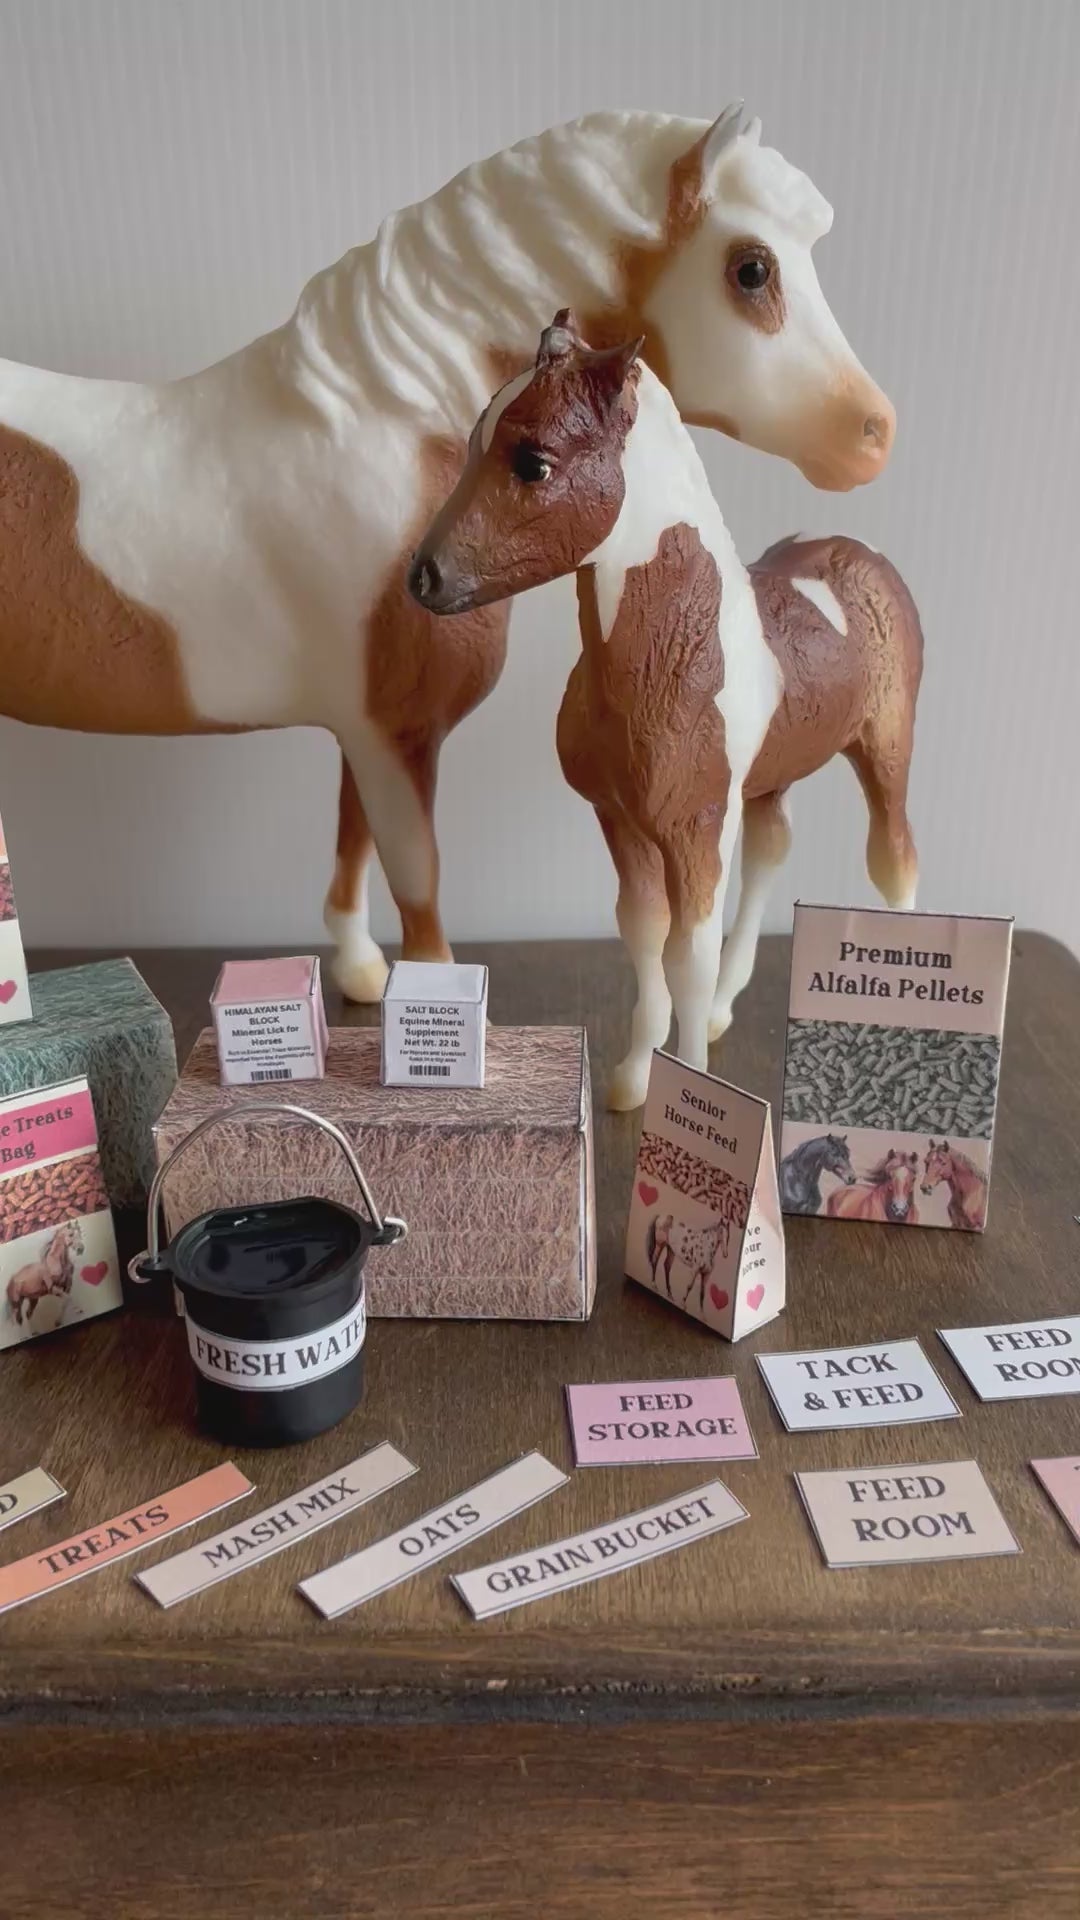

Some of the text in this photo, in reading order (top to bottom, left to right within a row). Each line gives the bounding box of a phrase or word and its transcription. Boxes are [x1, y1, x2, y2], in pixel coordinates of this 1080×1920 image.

[839, 941, 952, 969] Premium
[808, 972, 984, 1005] Alfalfa Pellets
[225, 1004, 302, 1017] HIMALAYAN SALT
[249, 1017, 280, 1025] BLOCK
[399, 1017, 465, 1027] Equine Mineral
[405, 1006, 460, 1015] SALT BLOCK
[232, 1025, 299, 1037] Mineral Lick for
[251, 1038, 283, 1047] Horses
[405, 1028, 459, 1038] Supplement
[422, 1039, 437, 1047] Wt.
[451, 1040, 460, 1048] lb
[680, 1087, 727, 1122] Senior
[13, 1105, 74, 1134] Treats
[664, 1104, 738, 1154] Horse Feed
[1, 1140, 37, 1164] Bag
[984, 1328, 1073, 1352] FEED
[196, 1336, 287, 1377] FRESH
[797, 1352, 898, 1379] TACK
[619, 1393, 693, 1412] FEED
[804, 1382, 924, 1411] & FEED
[588, 1418, 738, 1441] STORAGE
[846, 1475, 946, 1503] FEED
[201, 1477, 361, 1568] MASH MIX
[398, 1503, 481, 1557] OATS
[852, 1511, 977, 1543] ROOM
[38, 1504, 170, 1574] TREATS
[487, 1497, 716, 1593] GRAIN BUCKET
